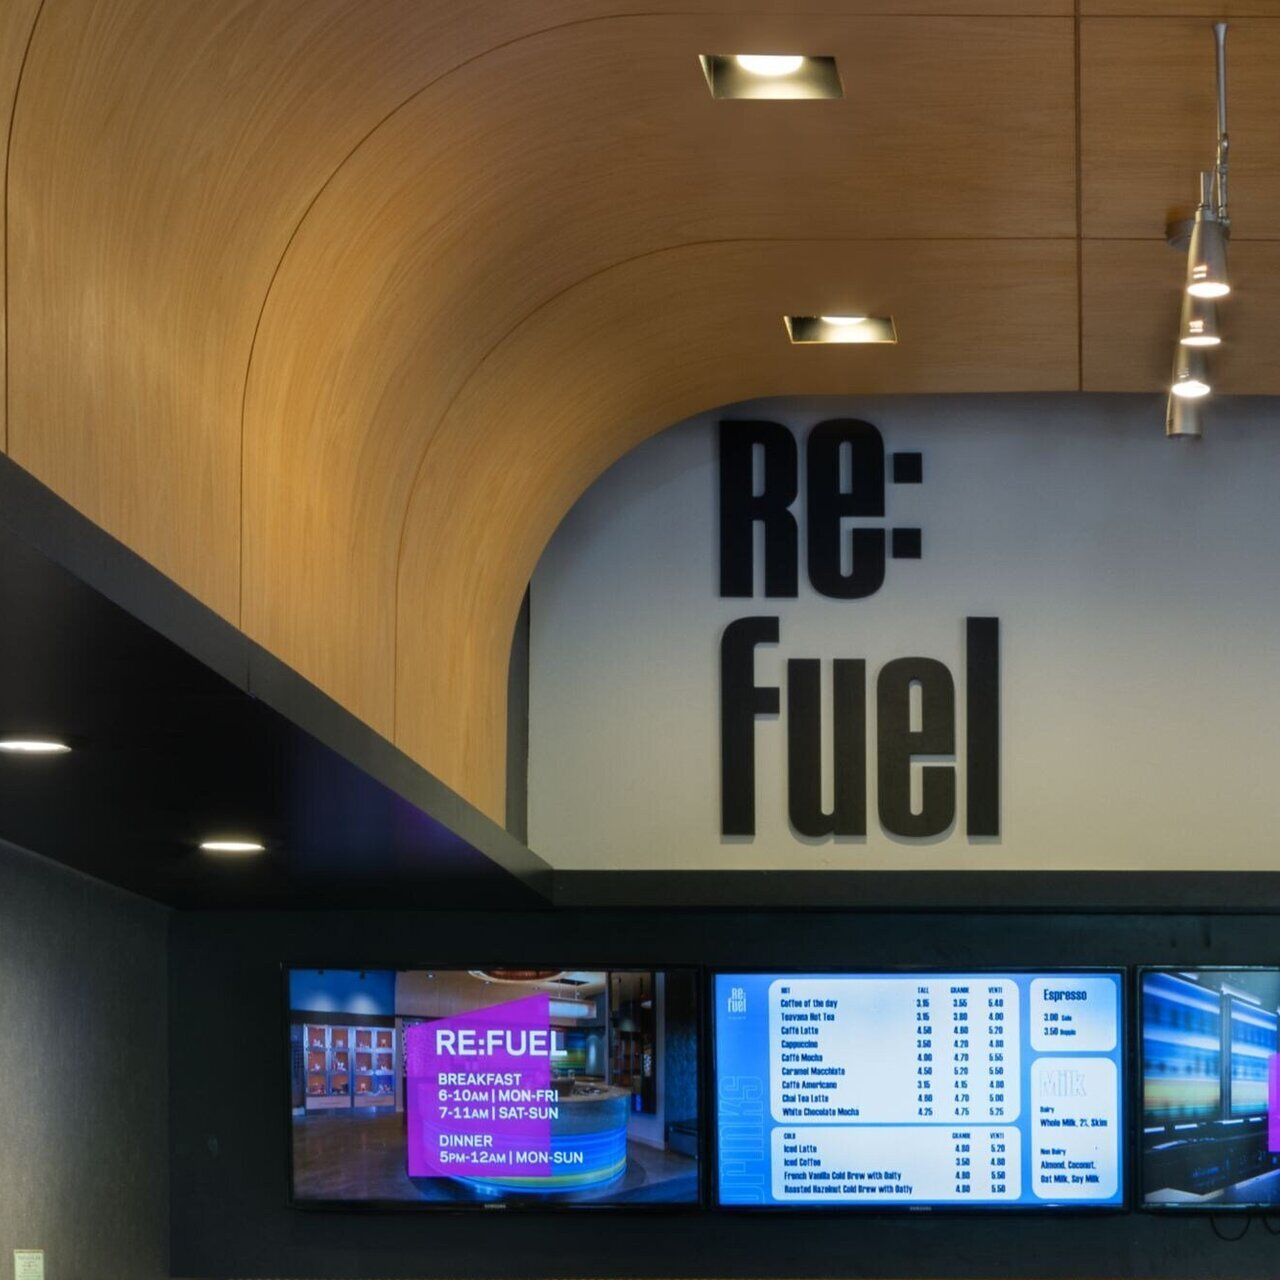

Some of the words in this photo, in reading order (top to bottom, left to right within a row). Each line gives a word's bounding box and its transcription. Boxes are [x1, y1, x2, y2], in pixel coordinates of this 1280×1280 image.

[719, 418, 922, 599] Re:
[720, 616, 1000, 837] fuel
[1043, 989, 1087, 1002] Espresso
[436, 1030, 567, 1057] RE:FUEL
[438, 1073, 521, 1086] BREAKFAST
[438, 1089, 489, 1102] 6-10AM
[498, 1089, 558, 1102] MON-FRI
[439, 1107, 489, 1119] 7-11AM
[499, 1107, 558, 1119] SAT-SUN
[439, 1135, 493, 1147] DINNER
[799, 1145, 817, 1153] Latte
[439, 1151, 506, 1164] 5PM-12AM
[516, 1151, 583, 1164] MON-SUN
